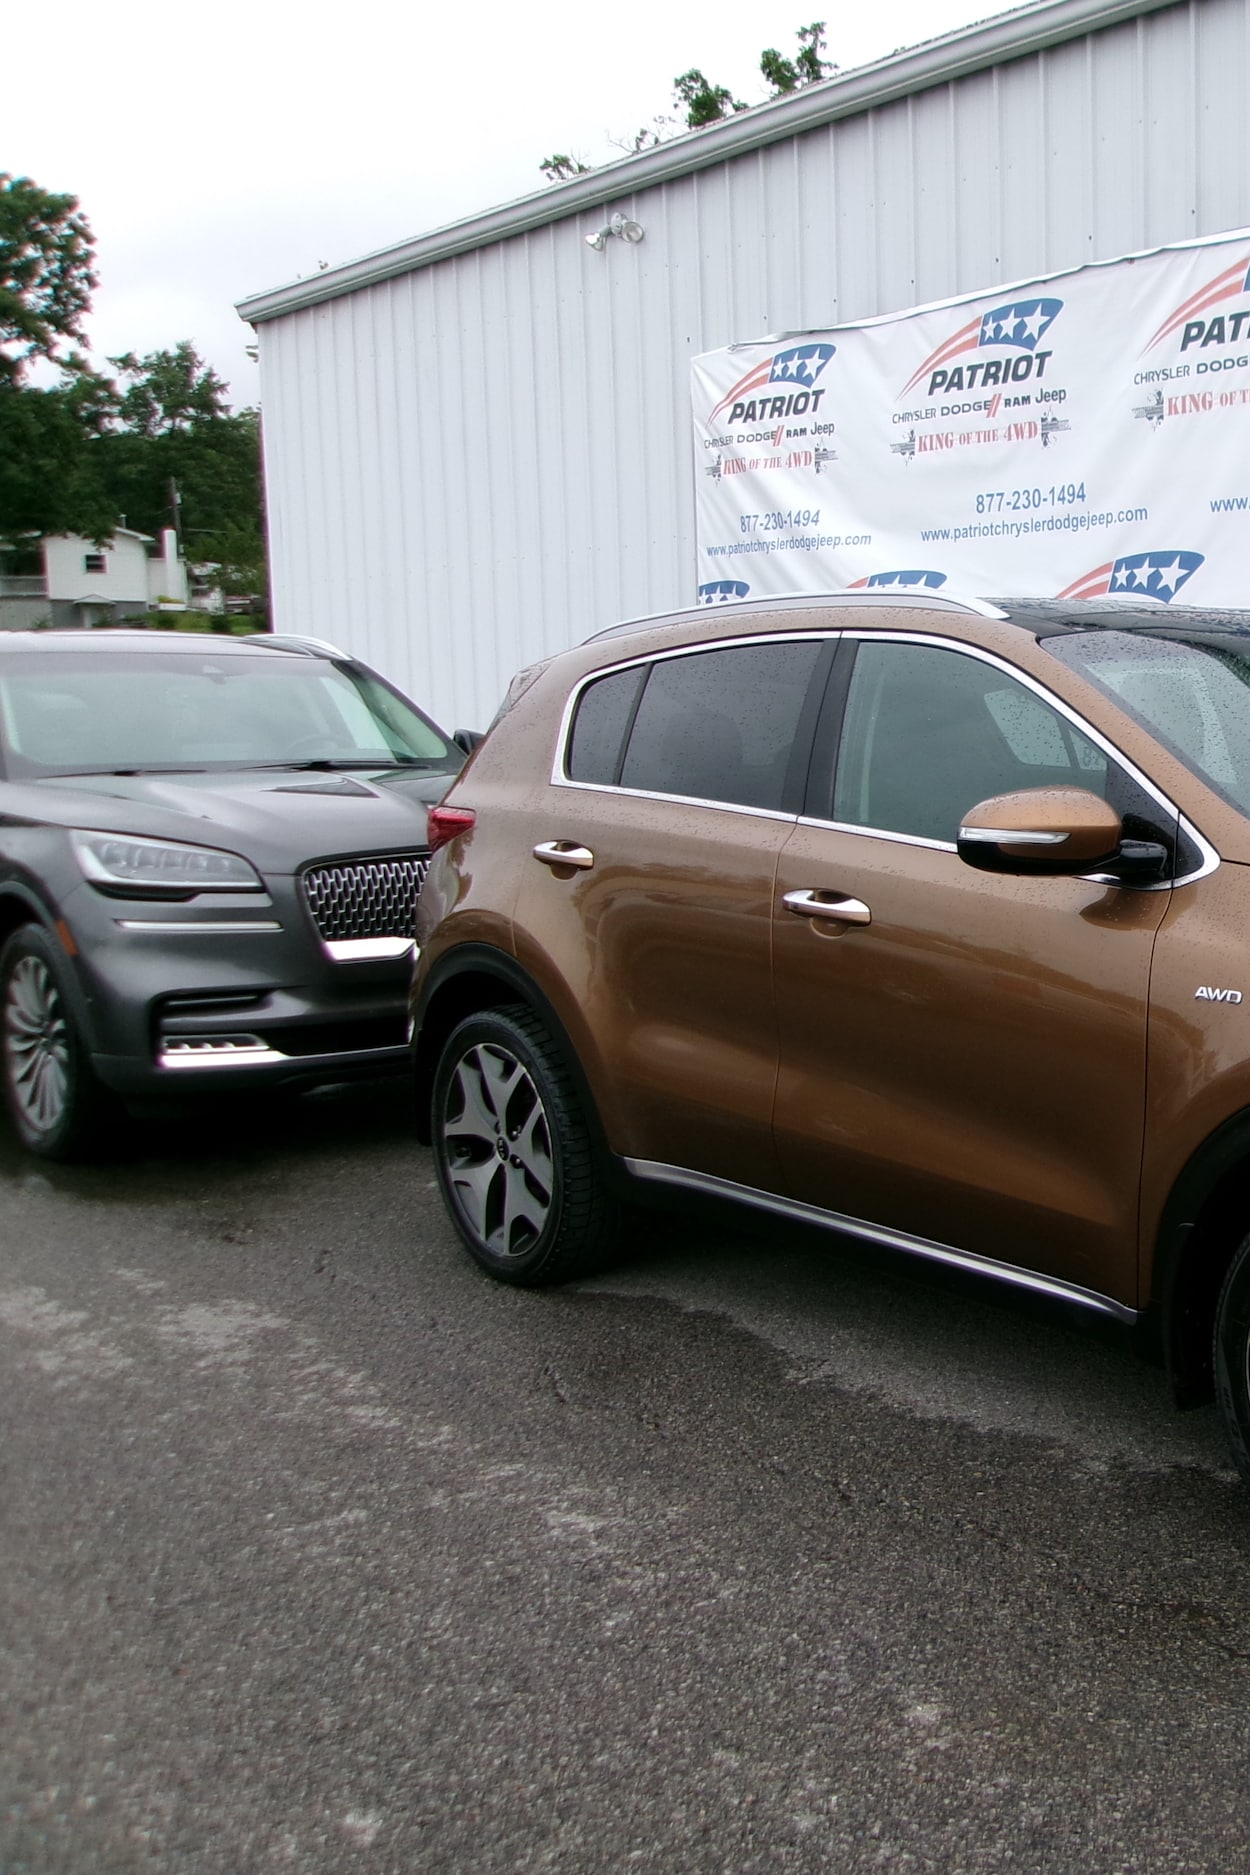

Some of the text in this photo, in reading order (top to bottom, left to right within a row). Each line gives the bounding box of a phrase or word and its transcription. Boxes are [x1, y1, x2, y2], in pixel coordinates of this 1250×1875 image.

[928, 350, 1053, 396] PATRIOT
[1133, 365, 1190, 385] CHRYSLER
[727, 388, 826, 425] PATRIOT
[892, 387, 1067, 425] CHRYSLER DODGE RAM Jeep
[1167, 391, 1214, 417] KING
[1220, 391, 1237, 409] OF
[704, 421, 835, 449] CHRYSLER DODGE RAM Jeep
[918, 421, 1038, 453] KING OF THE 4WD
[723, 451, 812, 475] KING OF THE 4WD
[976, 482, 1086, 514] 877-230-1494
[740, 509, 821, 533] 877-230-1494
[921, 507, 1148, 543] www.patriotchryslerdodgejeep.com
[706, 533, 872, 557] www.patriotchryslerdodgejeep.com
[1194, 986, 1243, 1005] AWD
